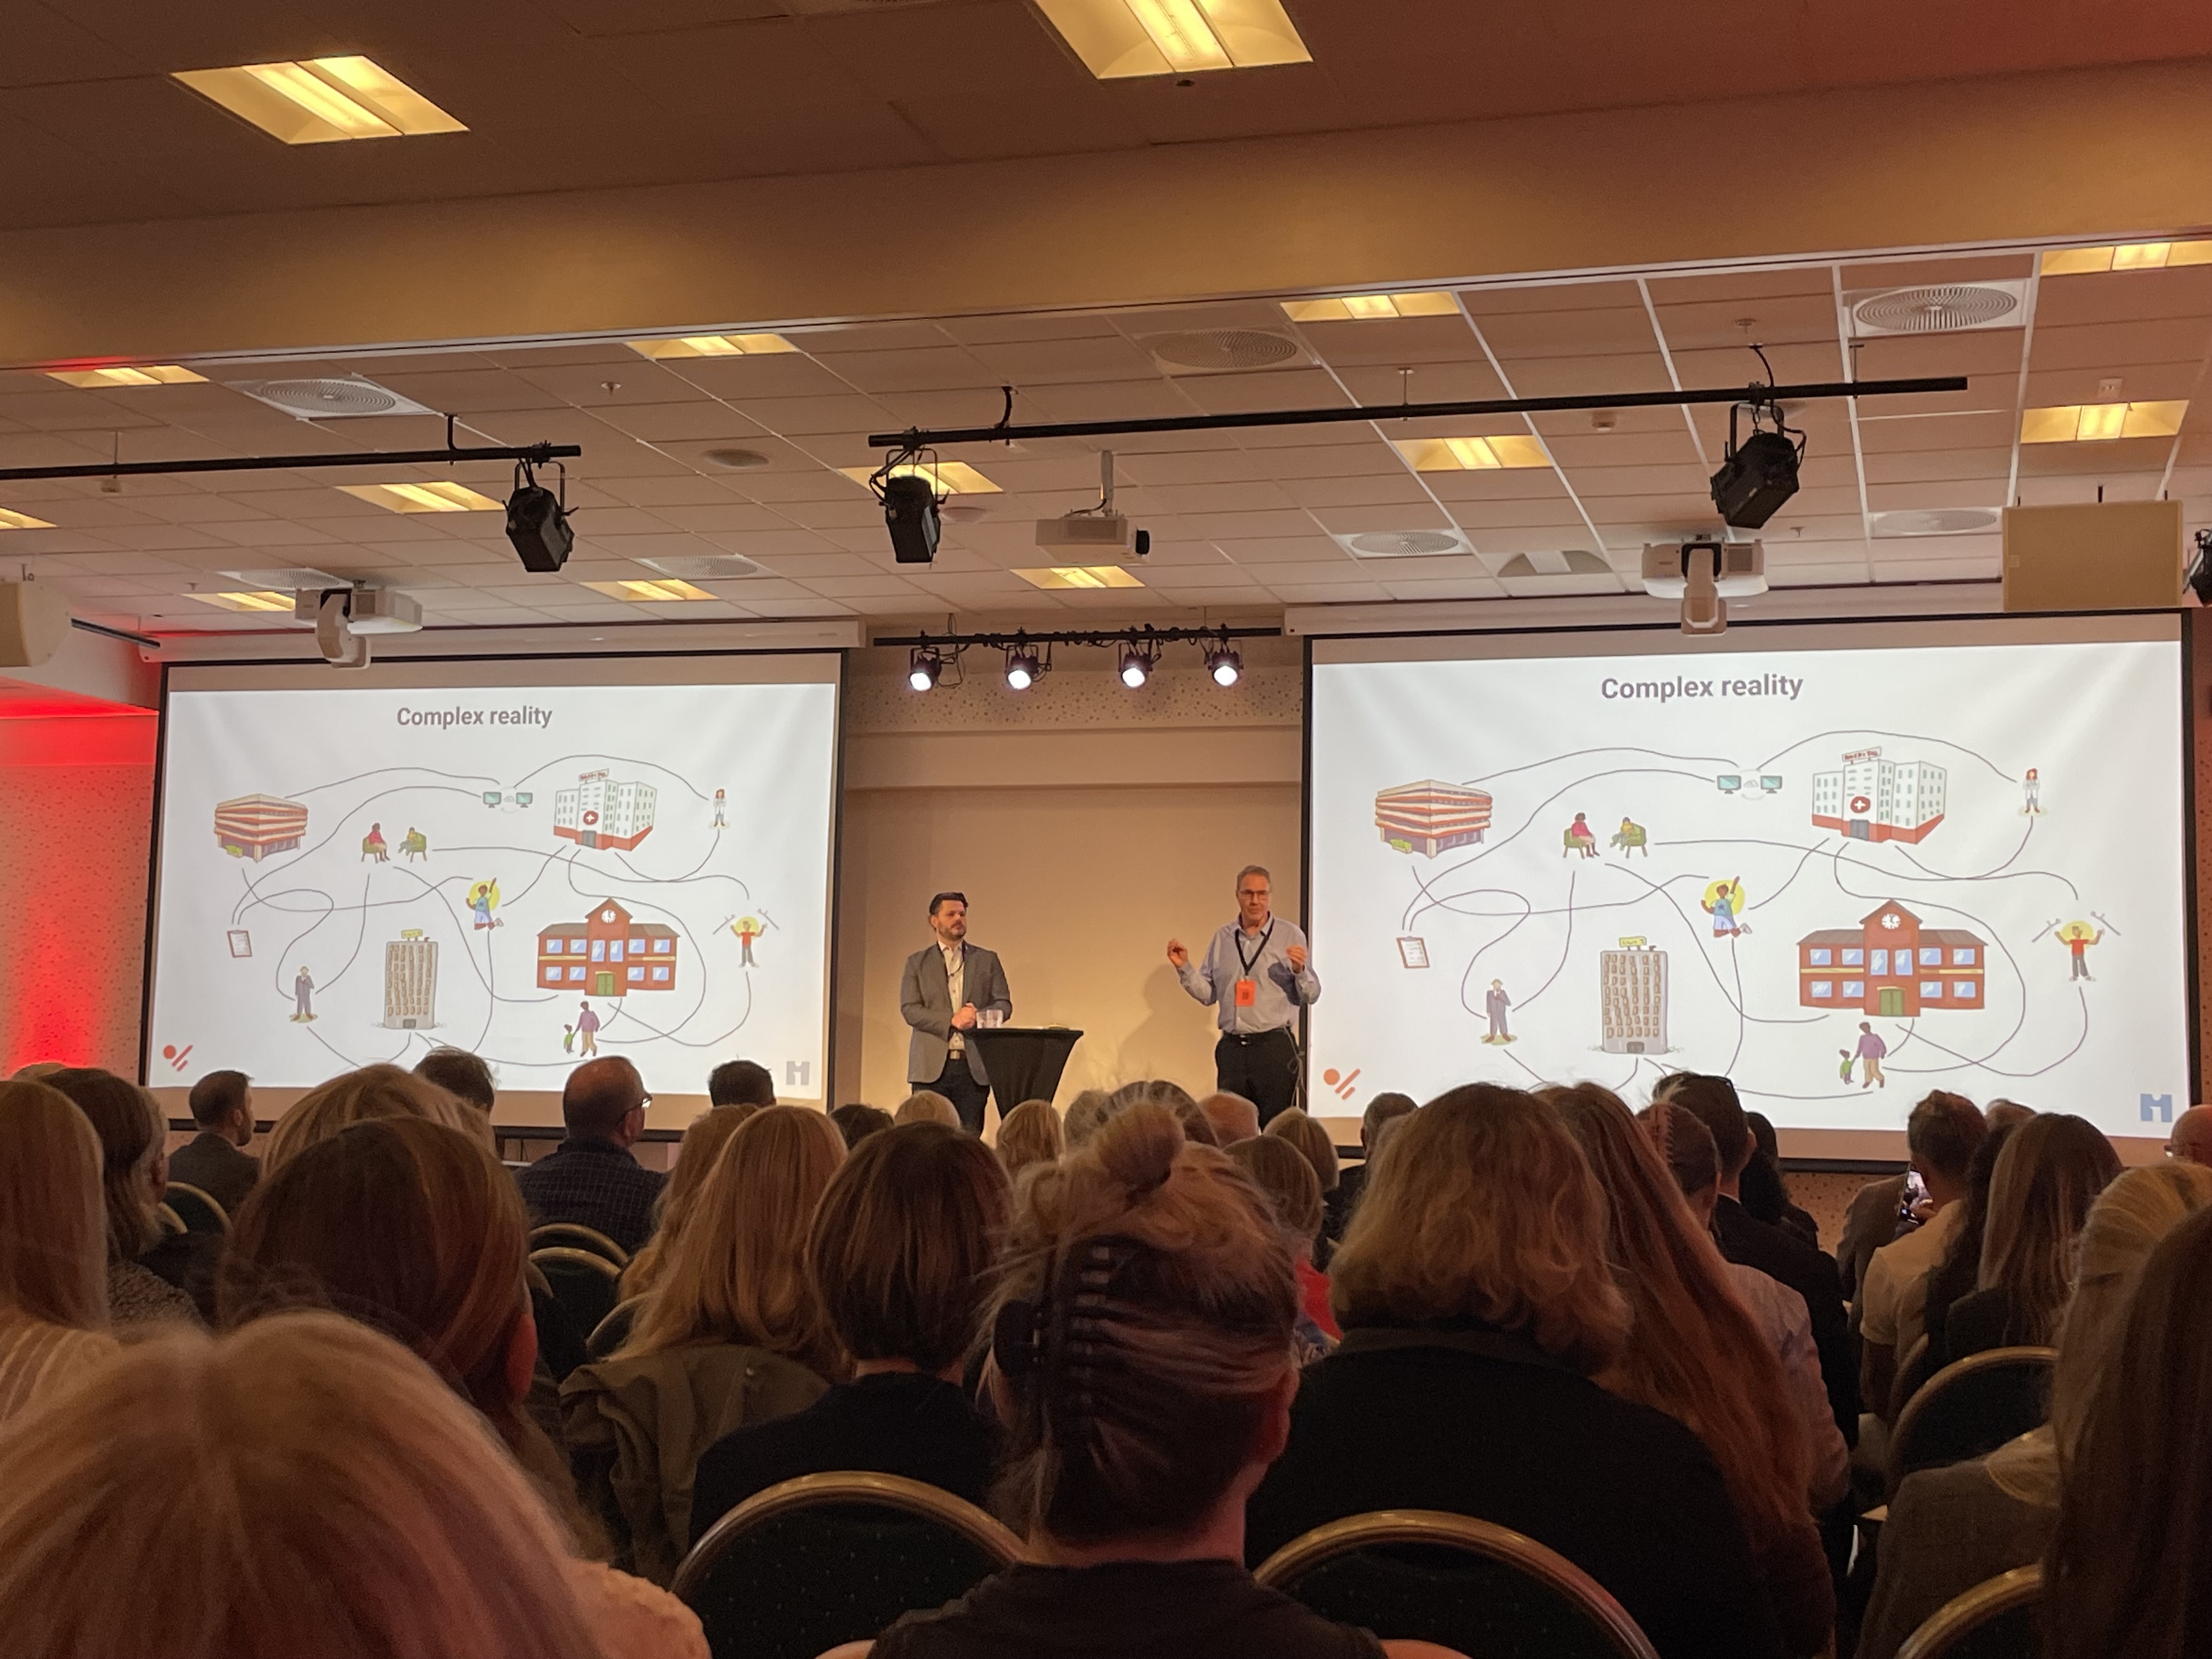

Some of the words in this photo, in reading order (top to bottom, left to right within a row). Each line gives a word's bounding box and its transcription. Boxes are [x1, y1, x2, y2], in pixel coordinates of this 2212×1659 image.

[1601, 675, 1713, 703] Complex
[1722, 673, 1804, 700] reality
[397, 706, 484, 730] Complex
[490, 705, 552, 729] reality
